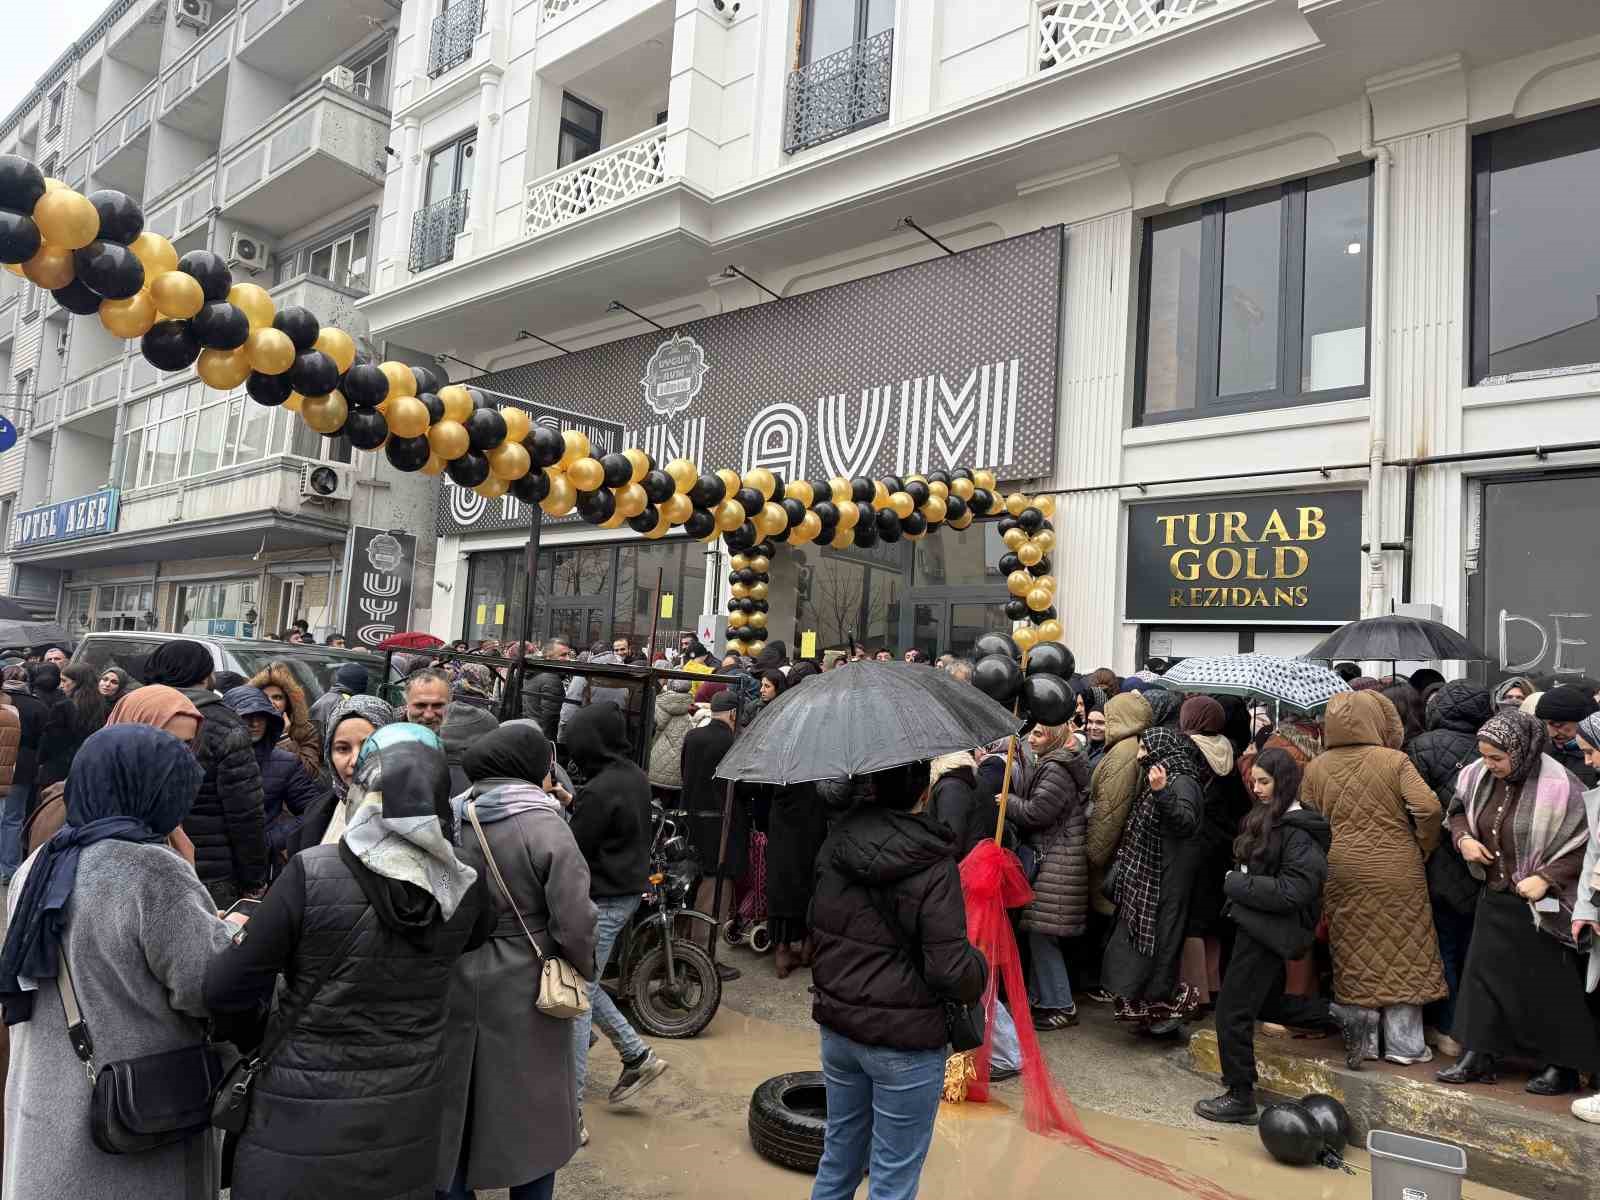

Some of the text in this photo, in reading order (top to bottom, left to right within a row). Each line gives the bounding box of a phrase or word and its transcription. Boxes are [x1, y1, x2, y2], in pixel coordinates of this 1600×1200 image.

[741, 359, 1019, 487] AVM
[14, 509, 57, 543] HOTEL
[1155, 506, 1327, 547] TURAB
[1169, 546, 1309, 581] GOLD
[1168, 586, 1309, 608] REZIDANS
